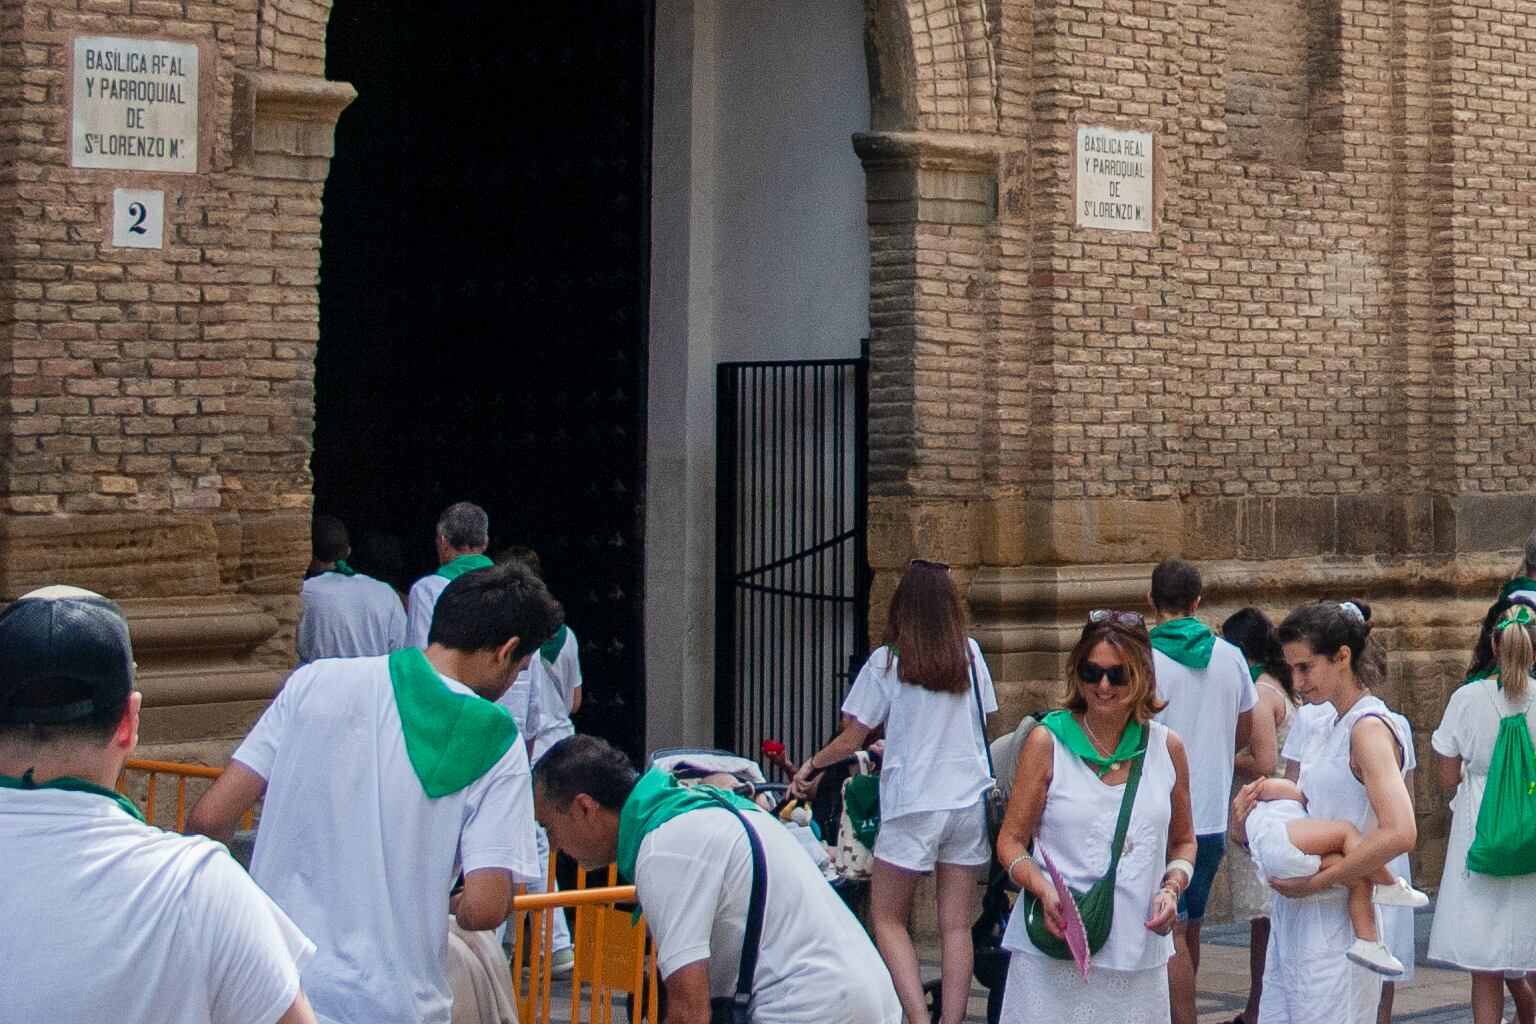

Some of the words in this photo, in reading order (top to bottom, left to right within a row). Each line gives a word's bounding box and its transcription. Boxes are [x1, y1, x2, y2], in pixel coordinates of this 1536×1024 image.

[86, 48, 147, 74] BASÍLICA
[86, 77, 95, 98] Y
[100, 78, 186, 105] PARROQUIAL
[126, 107, 145, 129] DE
[99, 134, 165, 158] LORENZO
[1084, 134, 1122, 155] BASÍLICA
[1124, 139, 1145, 158] REAL
[1084, 158, 1090, 173] Y
[1093, 158, 1145, 179] PARROQUIAL
[1109, 181, 1121, 198] DE
[128, 201, 147, 235] 2
[1093, 201, 1133, 220] LORENZO
